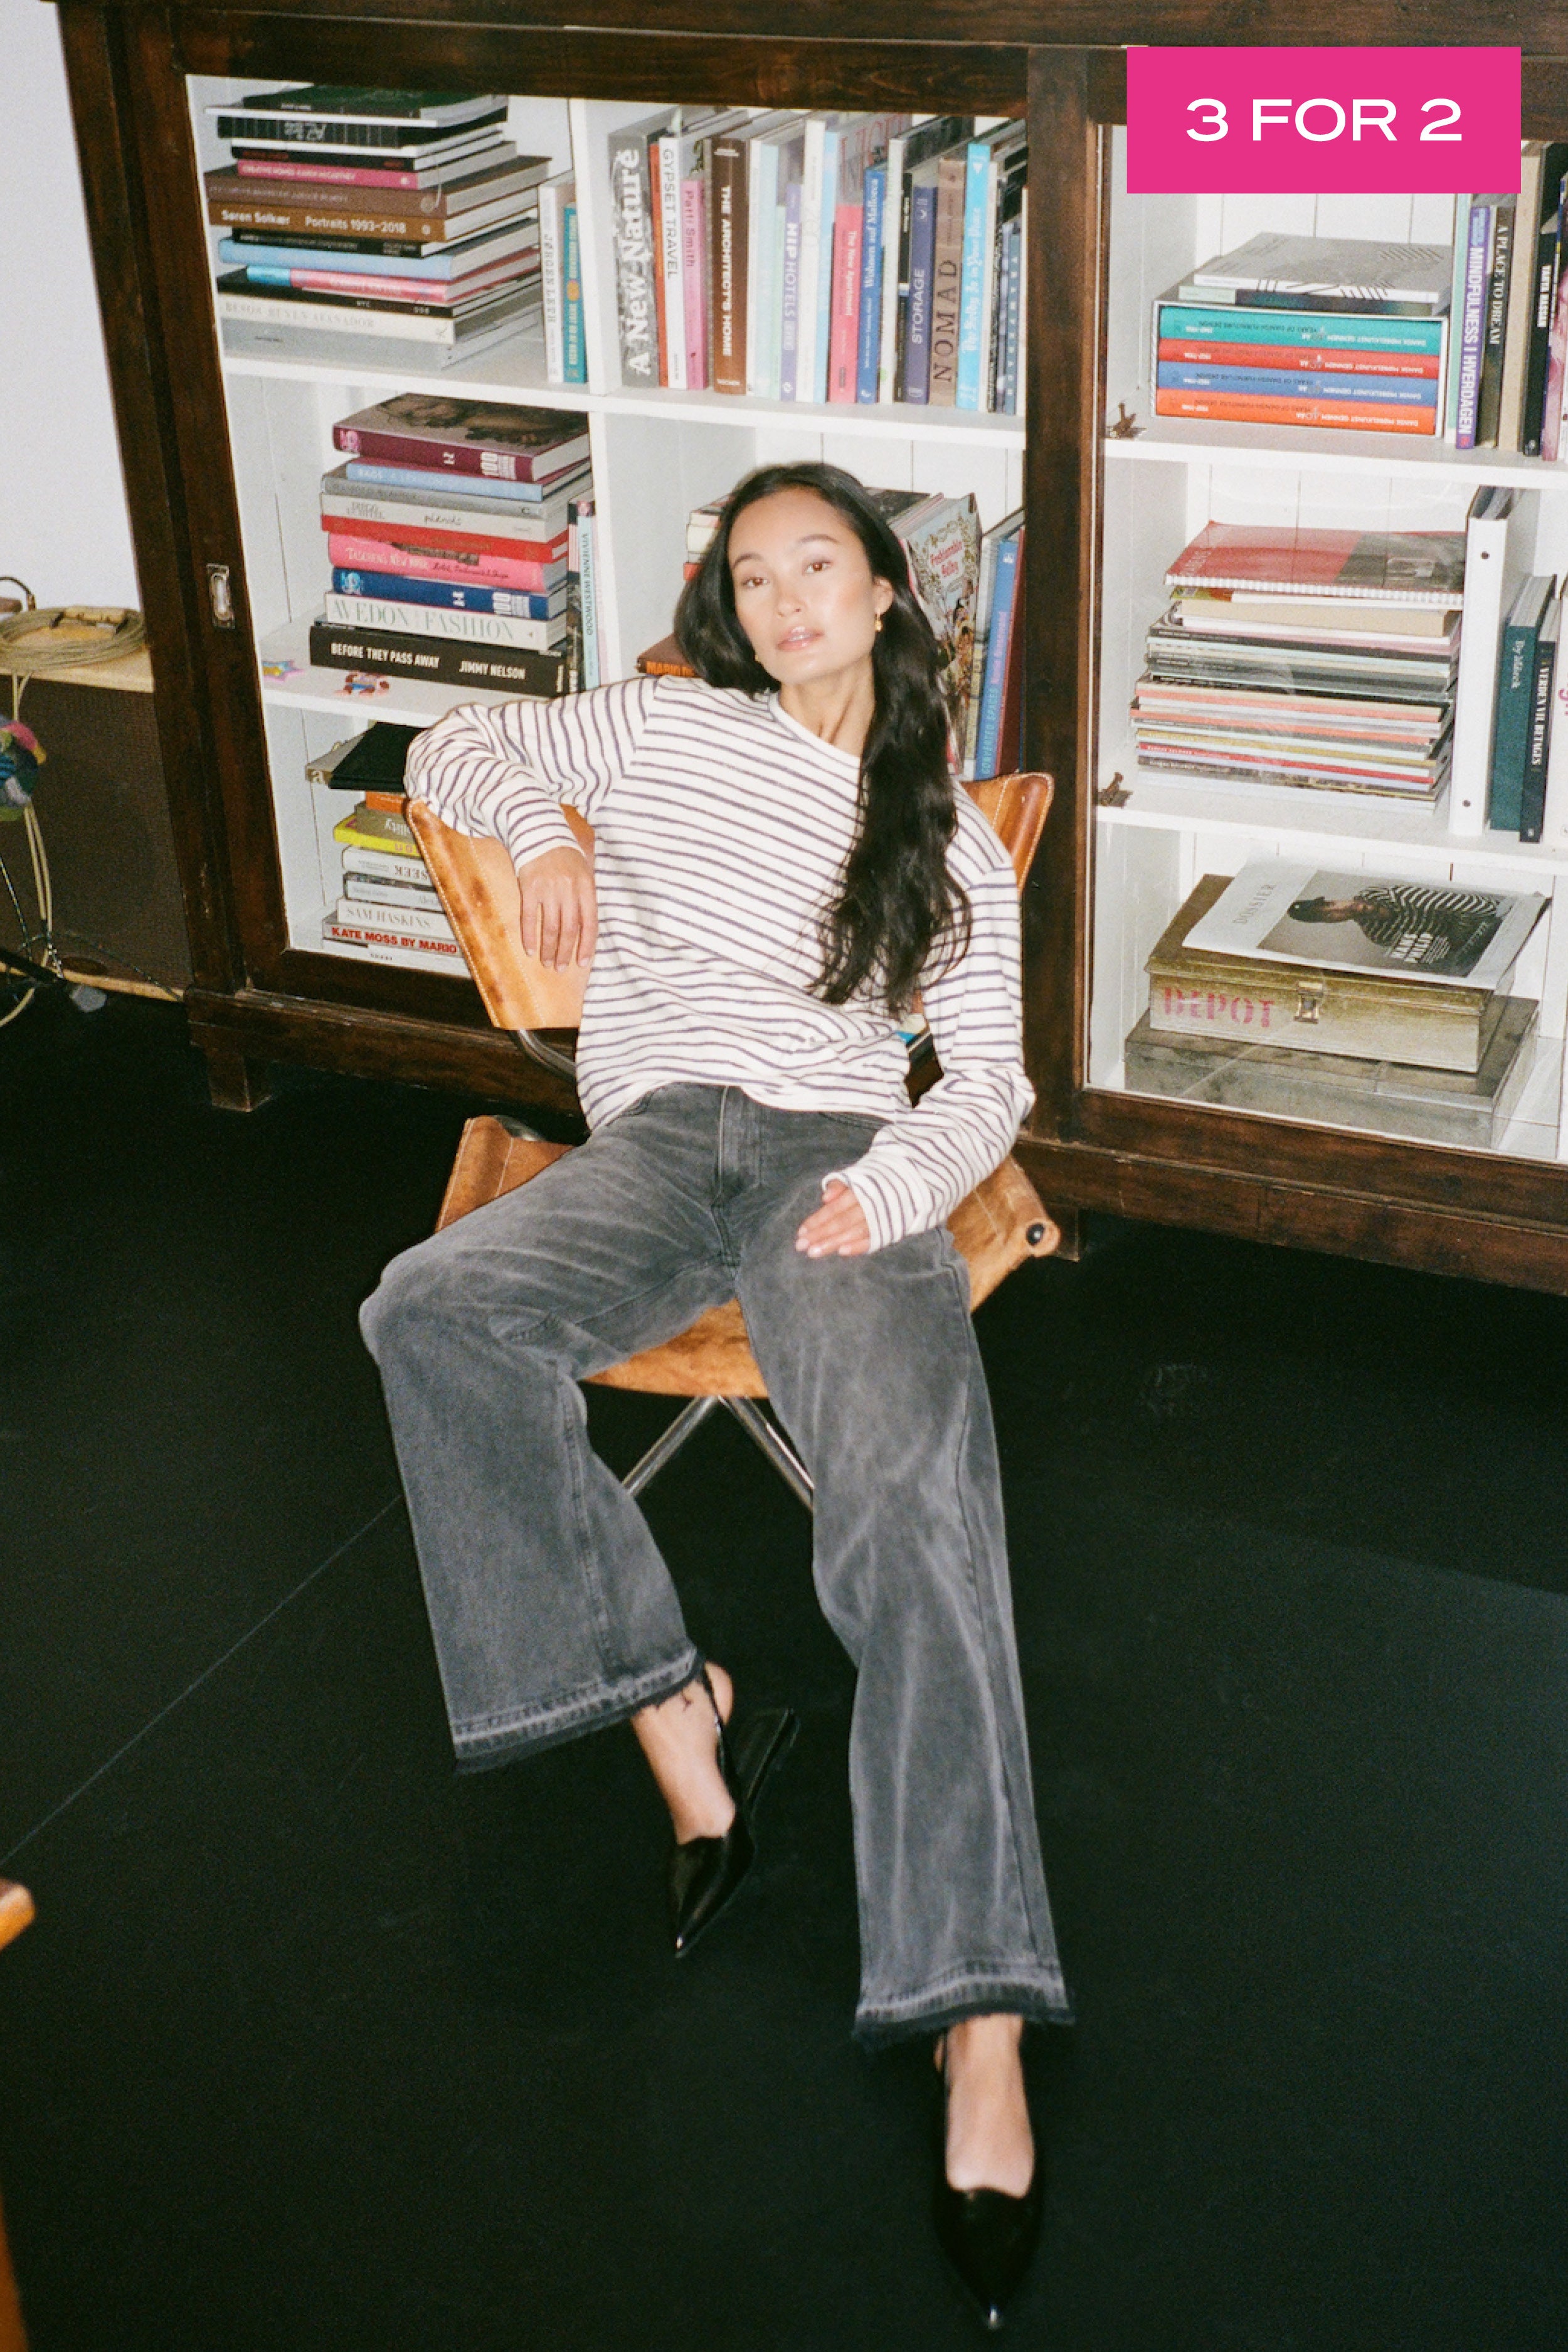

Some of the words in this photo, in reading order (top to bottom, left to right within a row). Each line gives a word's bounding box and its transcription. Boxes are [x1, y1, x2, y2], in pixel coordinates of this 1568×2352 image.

[663, 148, 675, 211] GYPSET
[615, 149, 652, 268] Nature
[684, 191, 695, 223] Patti
[721, 186, 731, 215] THE
[867, 179, 878, 224] Mallorca
[305, 215, 348, 231] Portraits
[786, 223, 798, 257] HIP
[866, 228, 877, 243] auf
[667, 220, 677, 278] TRAVEL
[686, 228, 695, 267] Smith
[864, 247, 876, 287] Wohnen
[1495, 236, 1508, 277] PLACE
[623, 274, 650, 342] New
[785, 260, 798, 318] HOTELS
[911, 268, 924, 344] STORAGE
[1463, 247, 1485, 344] MINDFULNESS
[1493, 280, 1505, 298] TO
[722, 314, 732, 356] HOME
[933, 260, 957, 382] NOMAD
[1489, 301, 1503, 344] DREAM
[628, 352, 650, 375] A
[1459, 355, 1476, 435] HVERDAGEN
[333, 599, 408, 627] AVEDON
[425, 611, 514, 640] FASHION
[331, 642, 364, 659] BEFORE
[366, 647, 388, 661] THEY
[391, 650, 412, 665] PASS
[414, 655, 440, 669] AWAY
[459, 660, 488, 676] JIMMY
[490, 664, 526, 679] NELSON
[332, 927, 362, 940] KATE
[364, 931, 398, 945] MOSS
[401, 937, 415, 947] BY
[419, 940, 458, 954] MARIO
[1163, 987, 1275, 1028] DEPOT
